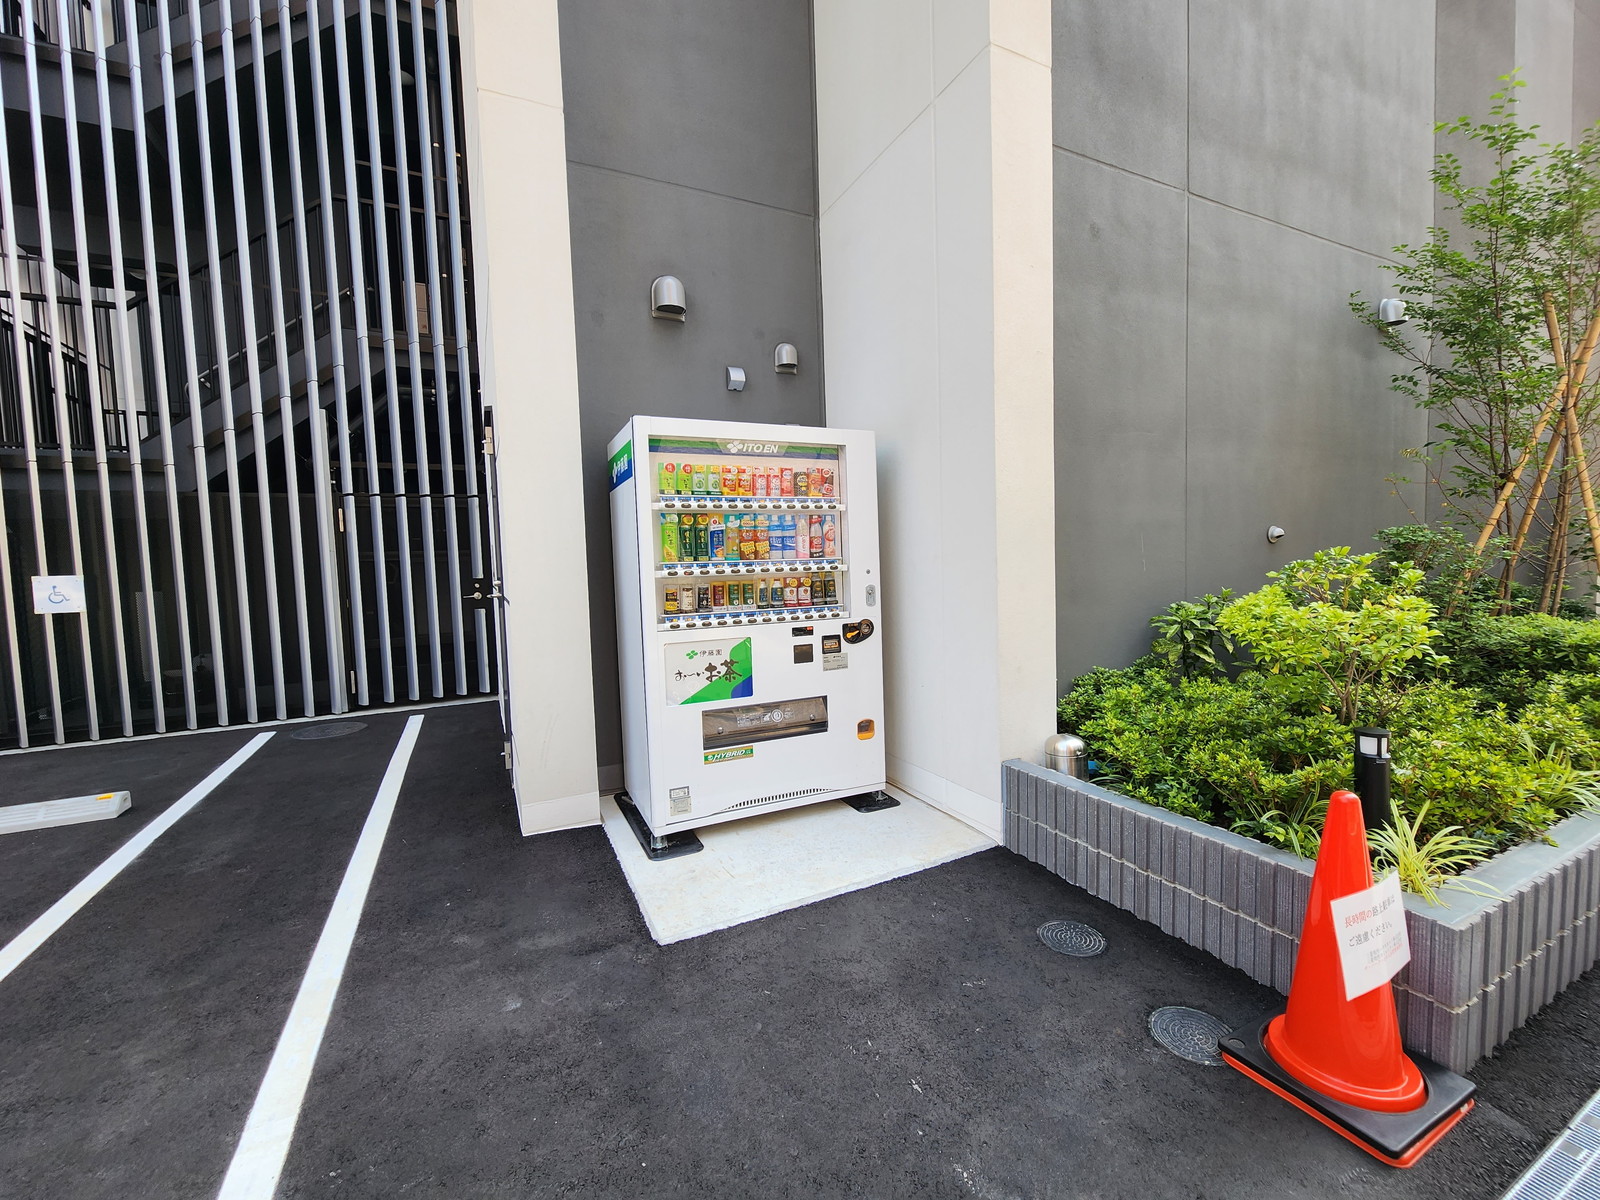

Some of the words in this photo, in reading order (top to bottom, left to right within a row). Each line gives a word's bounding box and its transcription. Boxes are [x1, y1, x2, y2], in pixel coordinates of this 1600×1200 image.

[742, 443, 763, 453] ITO
[763, 444, 779, 454] EN
[699, 649, 723, 657] 伊藤園
[712, 749, 746, 762] HYBRID
